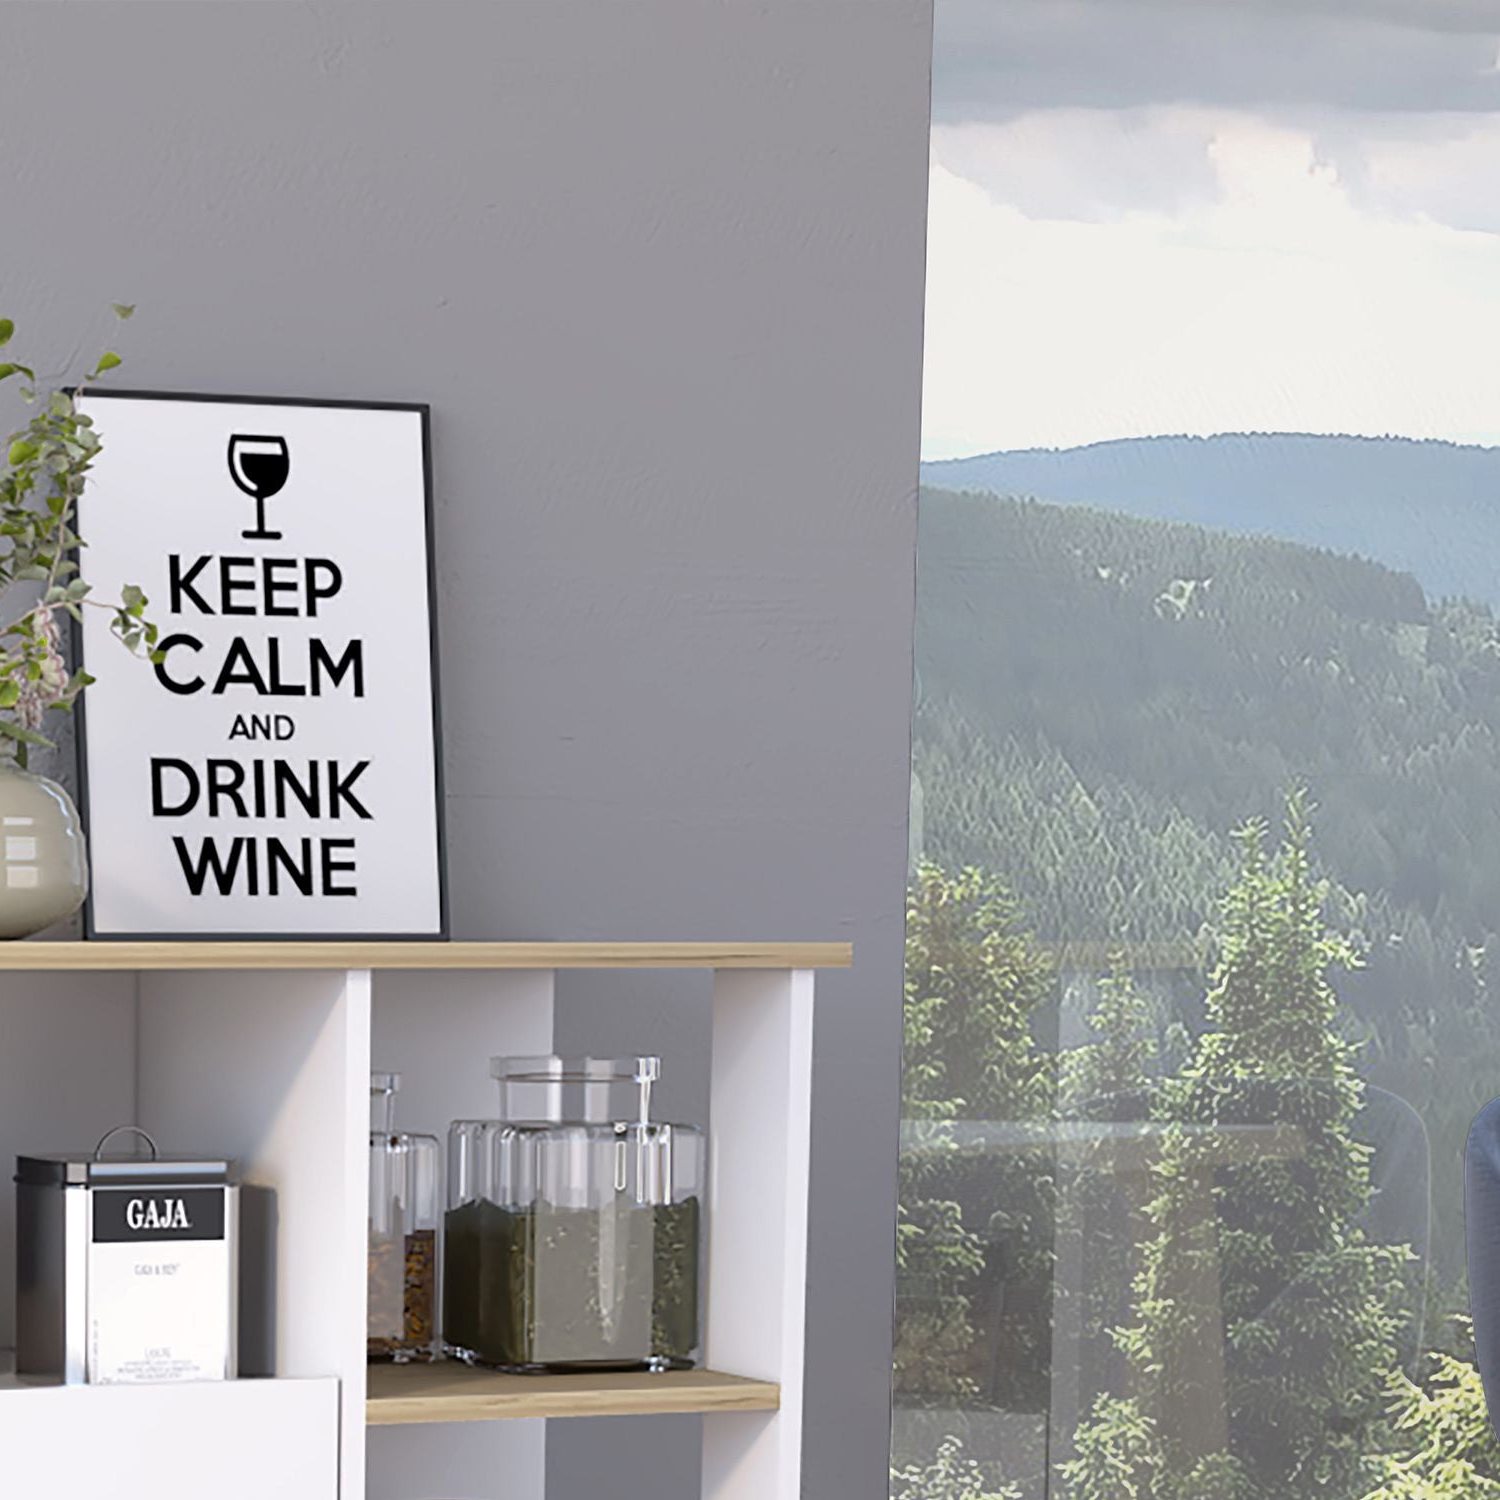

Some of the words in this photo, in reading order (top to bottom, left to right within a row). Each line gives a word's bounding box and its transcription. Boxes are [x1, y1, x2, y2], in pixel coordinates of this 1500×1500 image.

[168, 554, 343, 618] KEEP
[152, 633, 365, 698] CALM
[228, 714, 296, 742] AND
[150, 757, 374, 820] DRINK
[172, 836, 358, 897] WINE
[126, 1199, 189, 1230] GAJA
